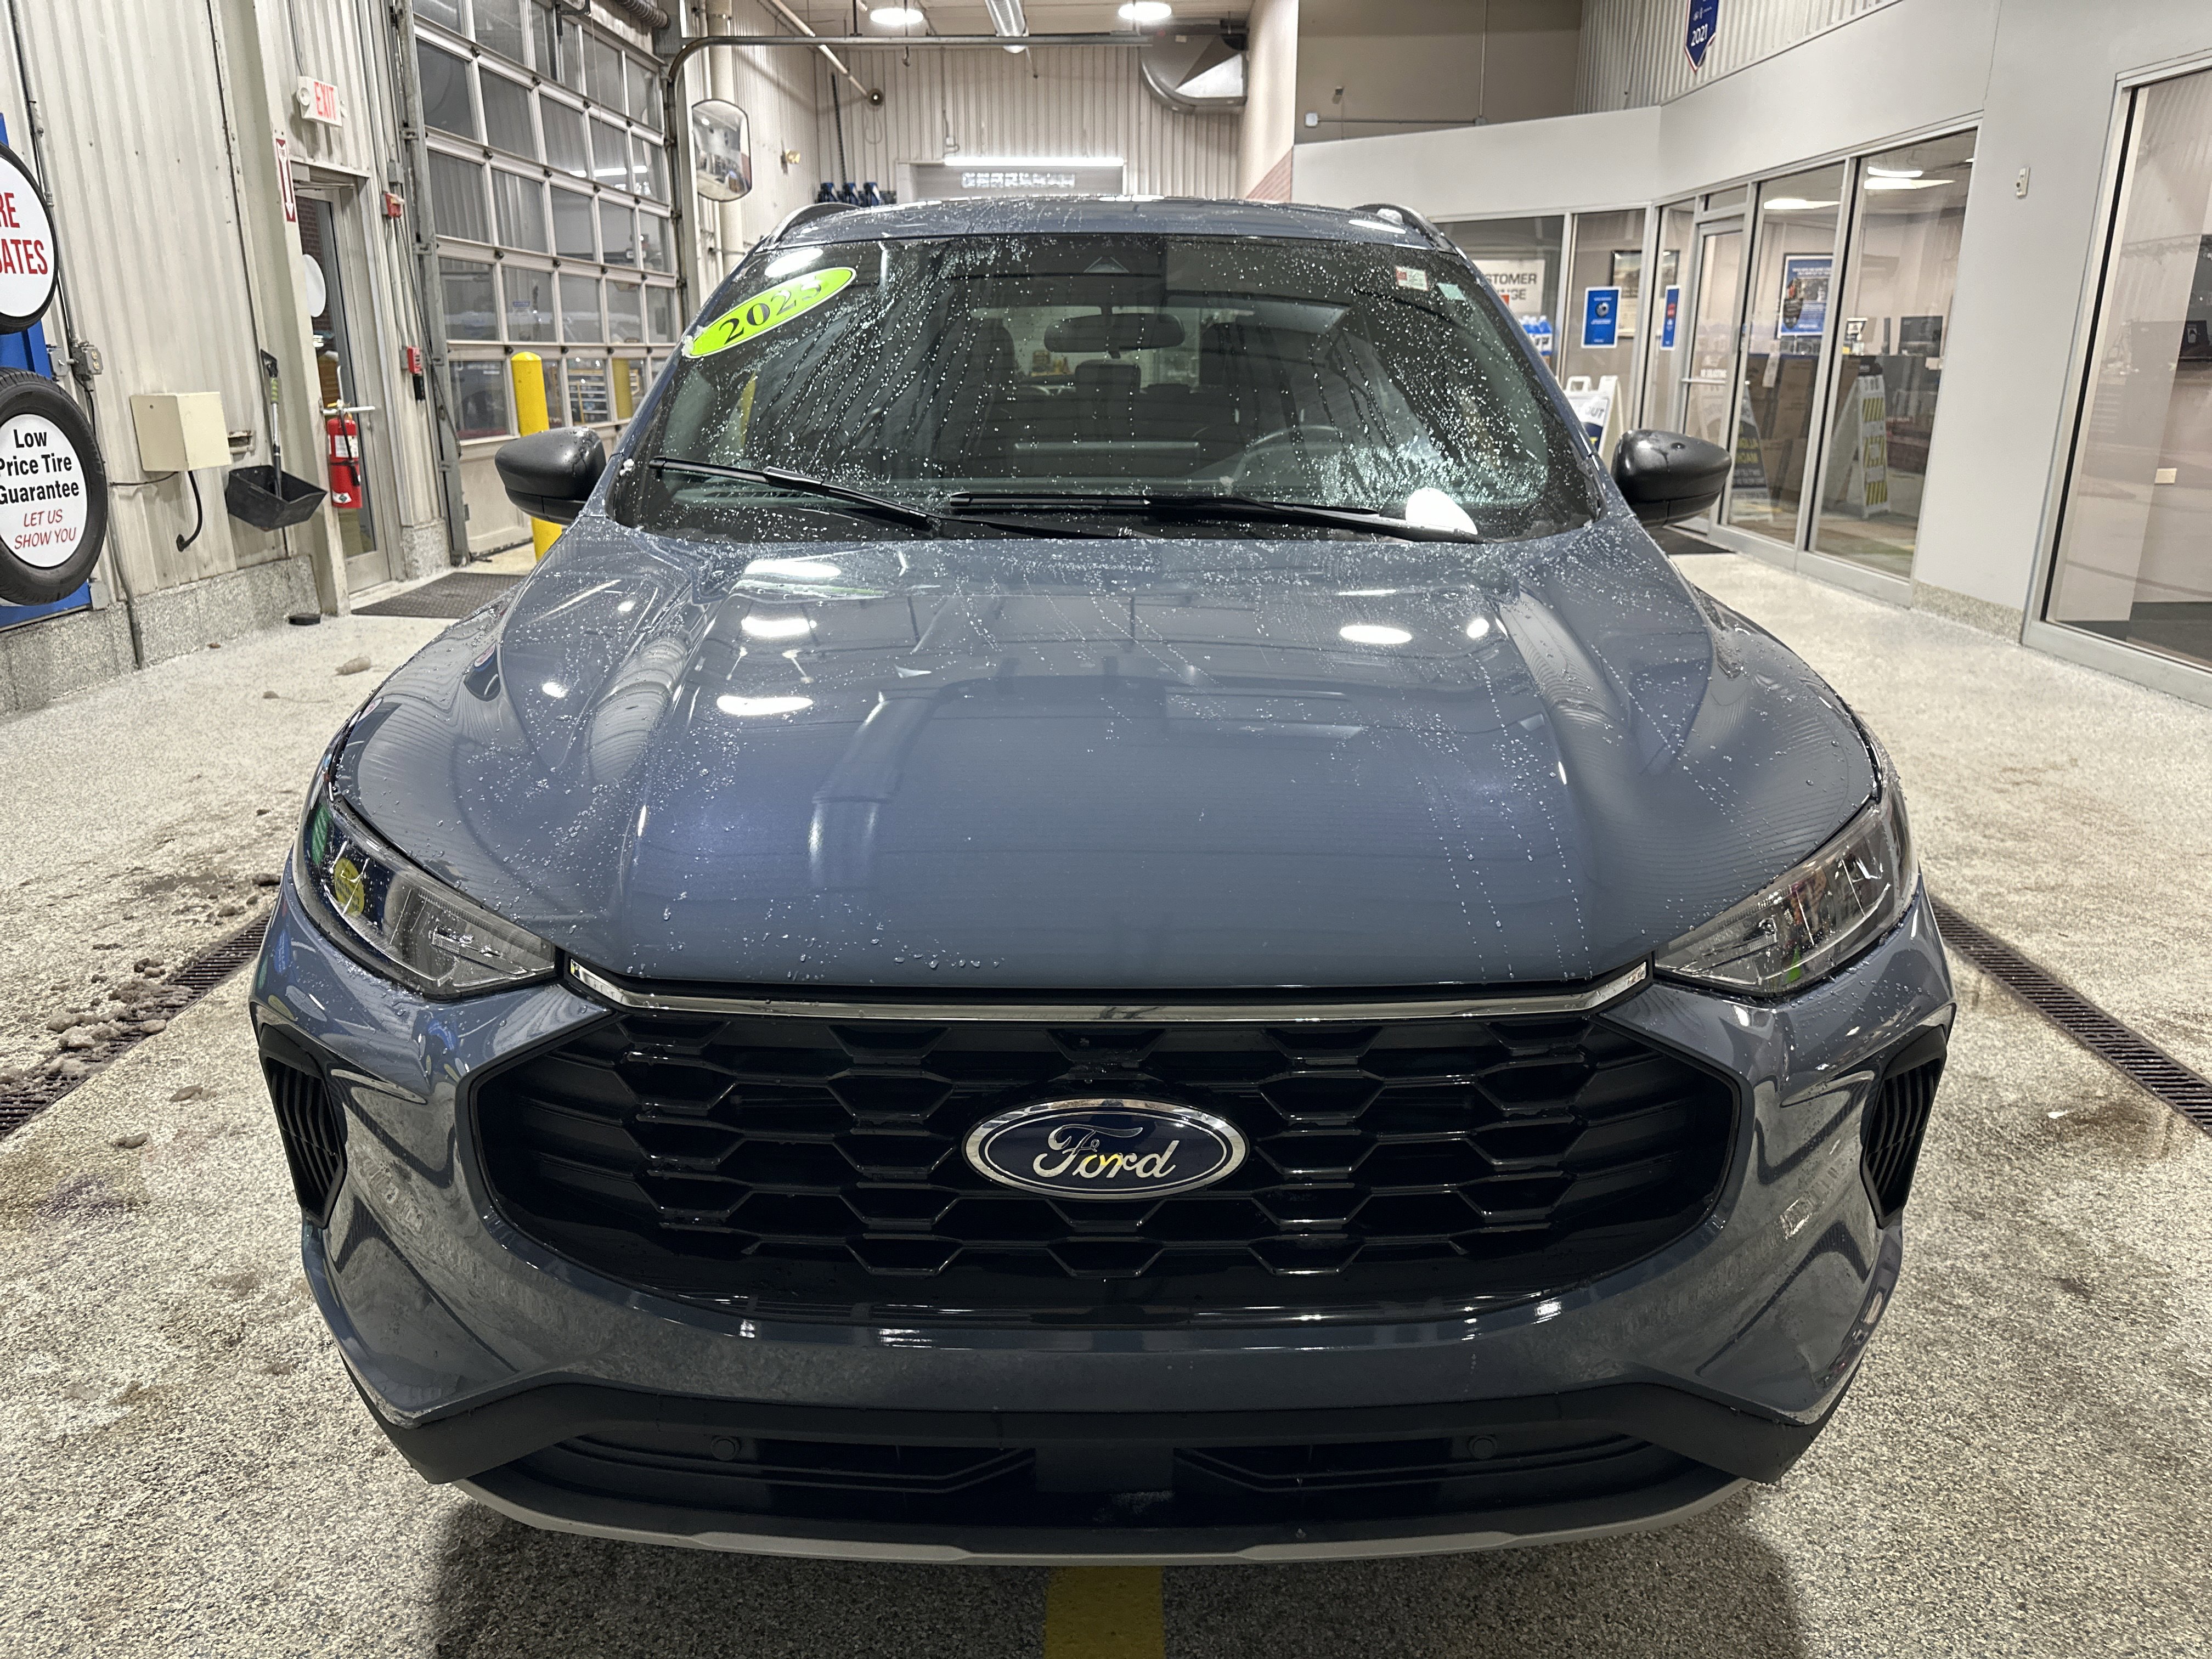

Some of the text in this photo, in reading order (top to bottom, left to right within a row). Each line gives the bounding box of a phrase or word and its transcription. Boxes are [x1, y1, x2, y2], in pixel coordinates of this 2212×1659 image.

[1691, 24, 1708, 47] 2021
[314, 81, 336, 121] EXIT
[0, 238, 48, 274] ATES
[719, 276, 822, 345] 2025
[13, 429, 47, 448] Low
[41, 453, 72, 473] Tire
[0, 480, 80, 505] Guarantee
[24, 509, 63, 527] LET US
[14, 527, 76, 549] SHOW YOU
[1033, 1124, 1180, 1178] Ford
